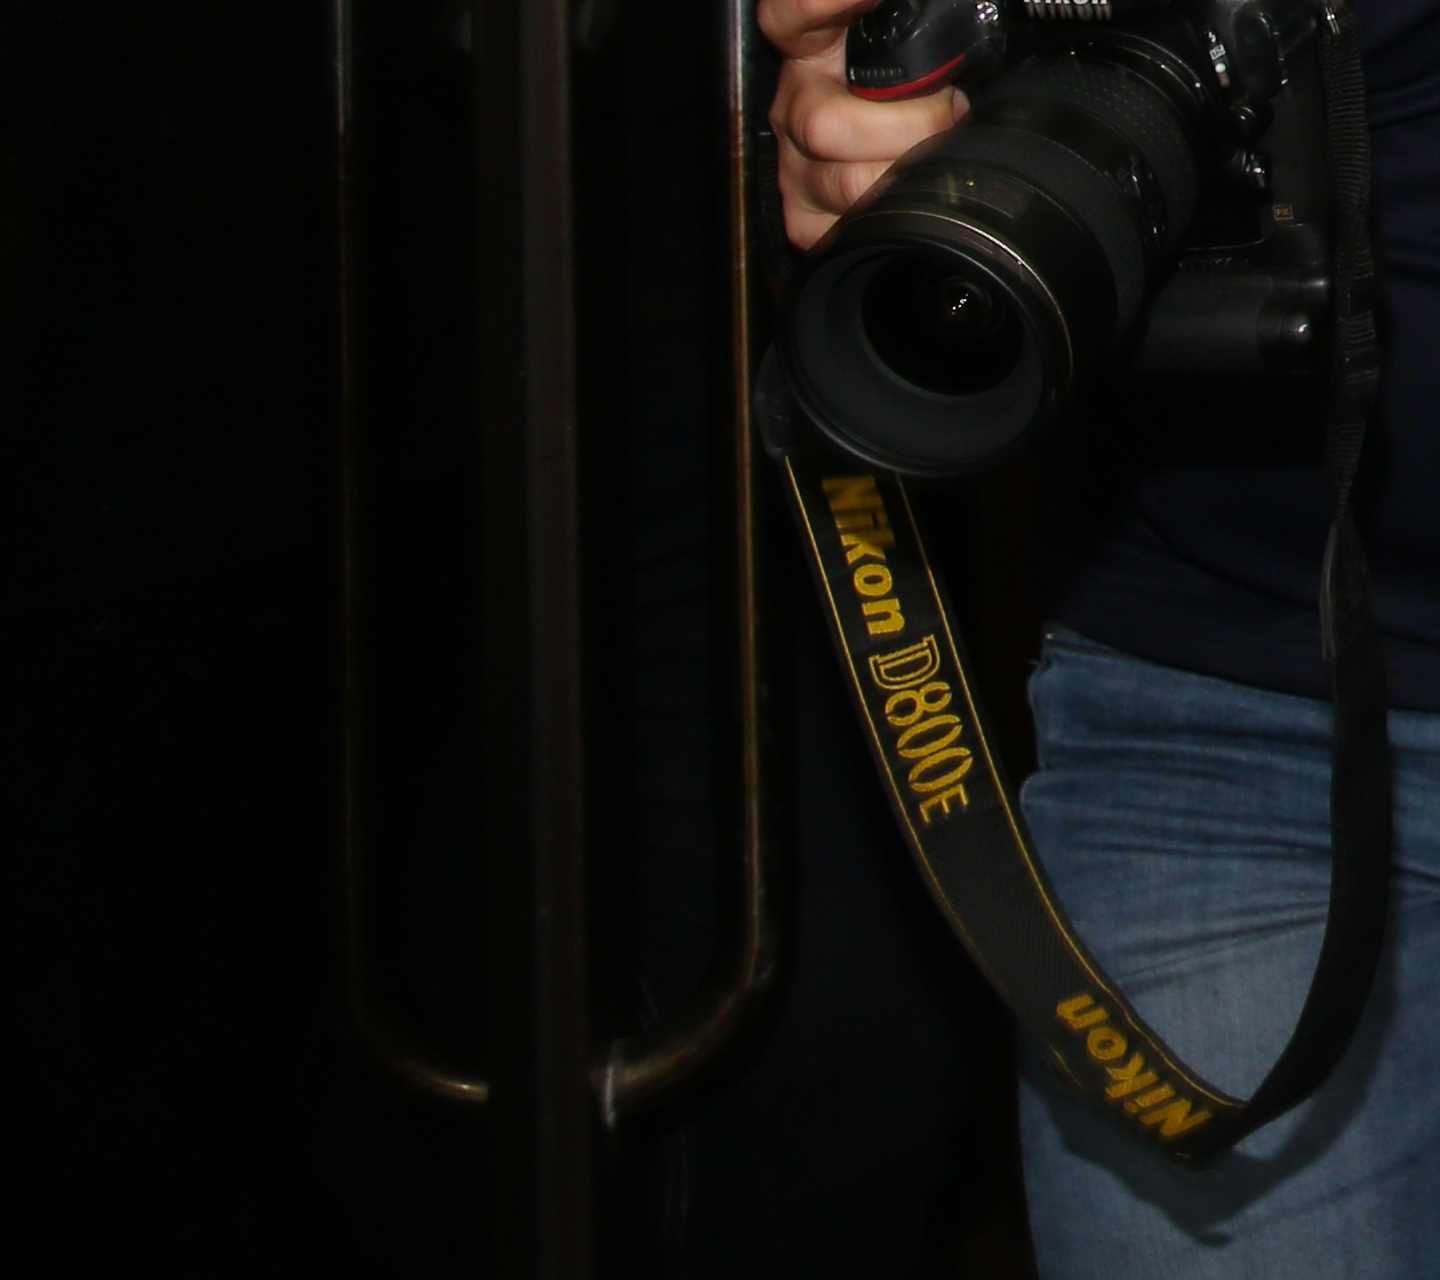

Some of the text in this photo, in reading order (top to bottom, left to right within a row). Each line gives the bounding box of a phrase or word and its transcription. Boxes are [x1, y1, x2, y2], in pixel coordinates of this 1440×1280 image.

[822, 474, 972, 824] Nikon D800E
[1056, 990, 1210, 1139] Nikon
